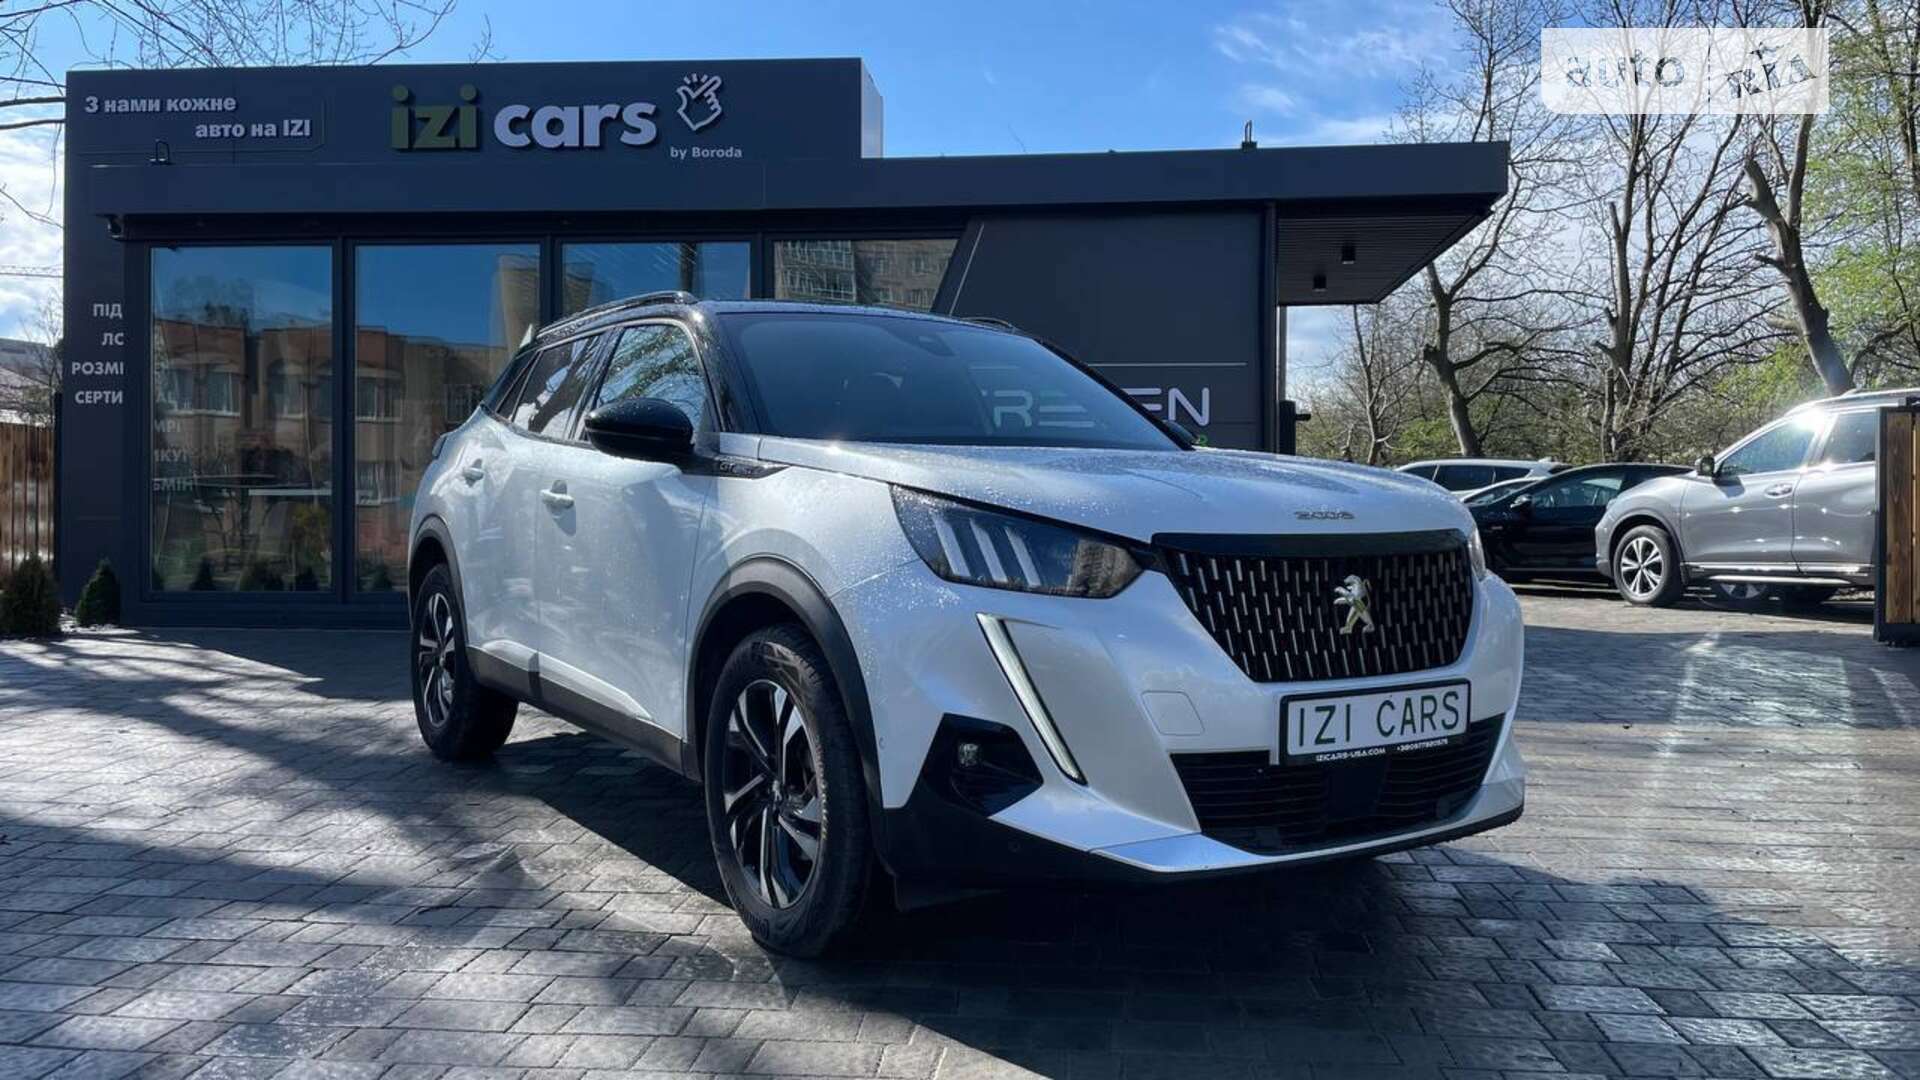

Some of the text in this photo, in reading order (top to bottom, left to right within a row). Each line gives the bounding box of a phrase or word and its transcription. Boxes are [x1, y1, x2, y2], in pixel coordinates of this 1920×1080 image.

[104, 99, 160, 113] нами
[166, 97, 236, 112] кожне
[391, 84, 658, 149] izi cars
[195, 119, 311, 138] авто на IZI
[670, 146, 742, 159] by Boroda
[93, 303, 122, 319] ПІД
[102, 332, 124, 346] ЛС
[71, 361, 124, 375] РОЗМІ
[75, 390, 123, 405] СЕРТИ
[1299, 690, 1460, 747] IZI CARS
